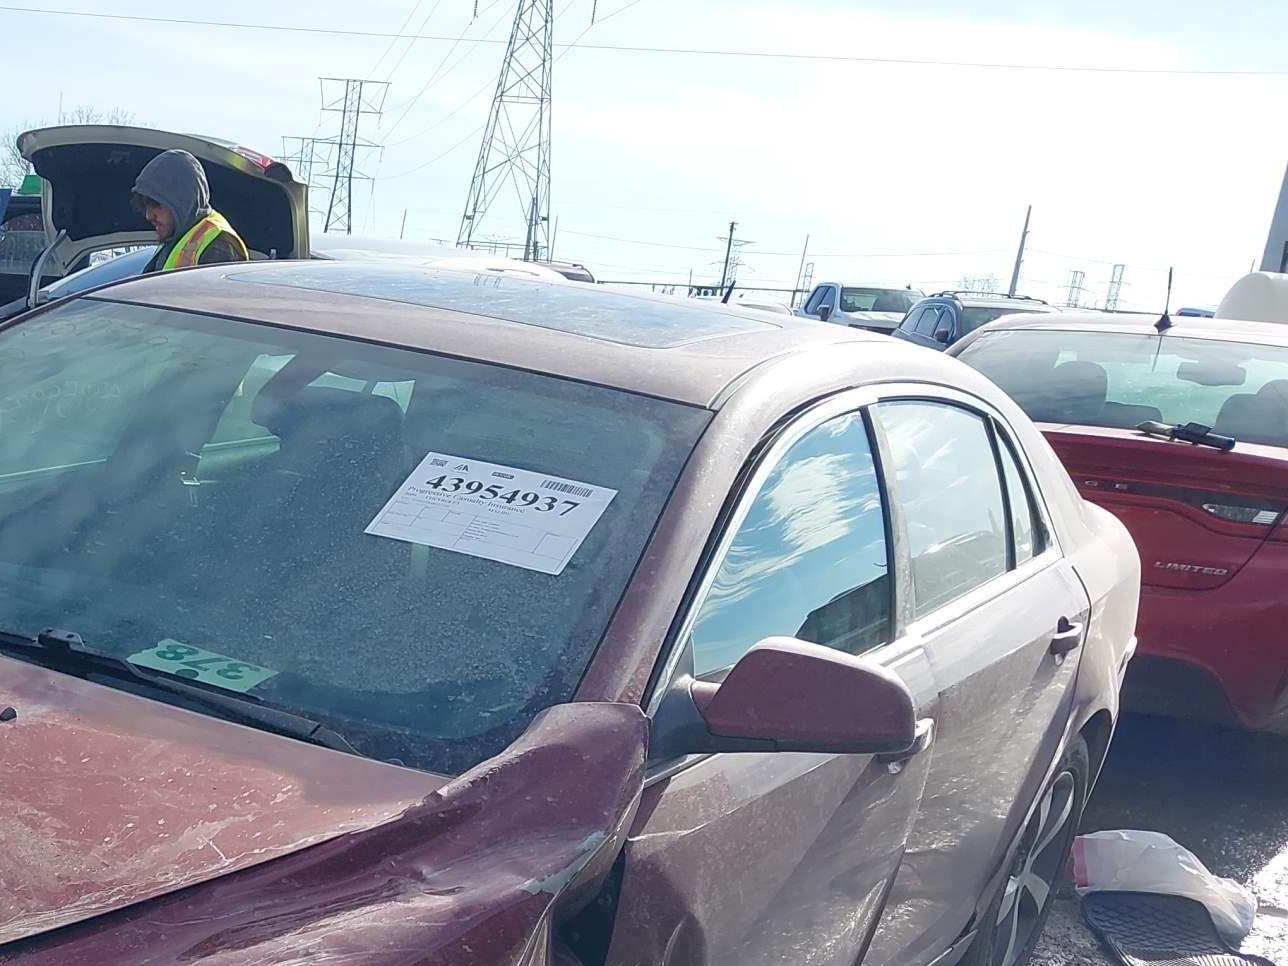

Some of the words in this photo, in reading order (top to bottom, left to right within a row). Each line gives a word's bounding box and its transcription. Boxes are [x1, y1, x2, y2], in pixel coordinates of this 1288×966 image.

[425, 474, 582, 517] 43954937
[1153, 560, 1229, 577] LIMITED
[155, 644, 262, 681] 378
